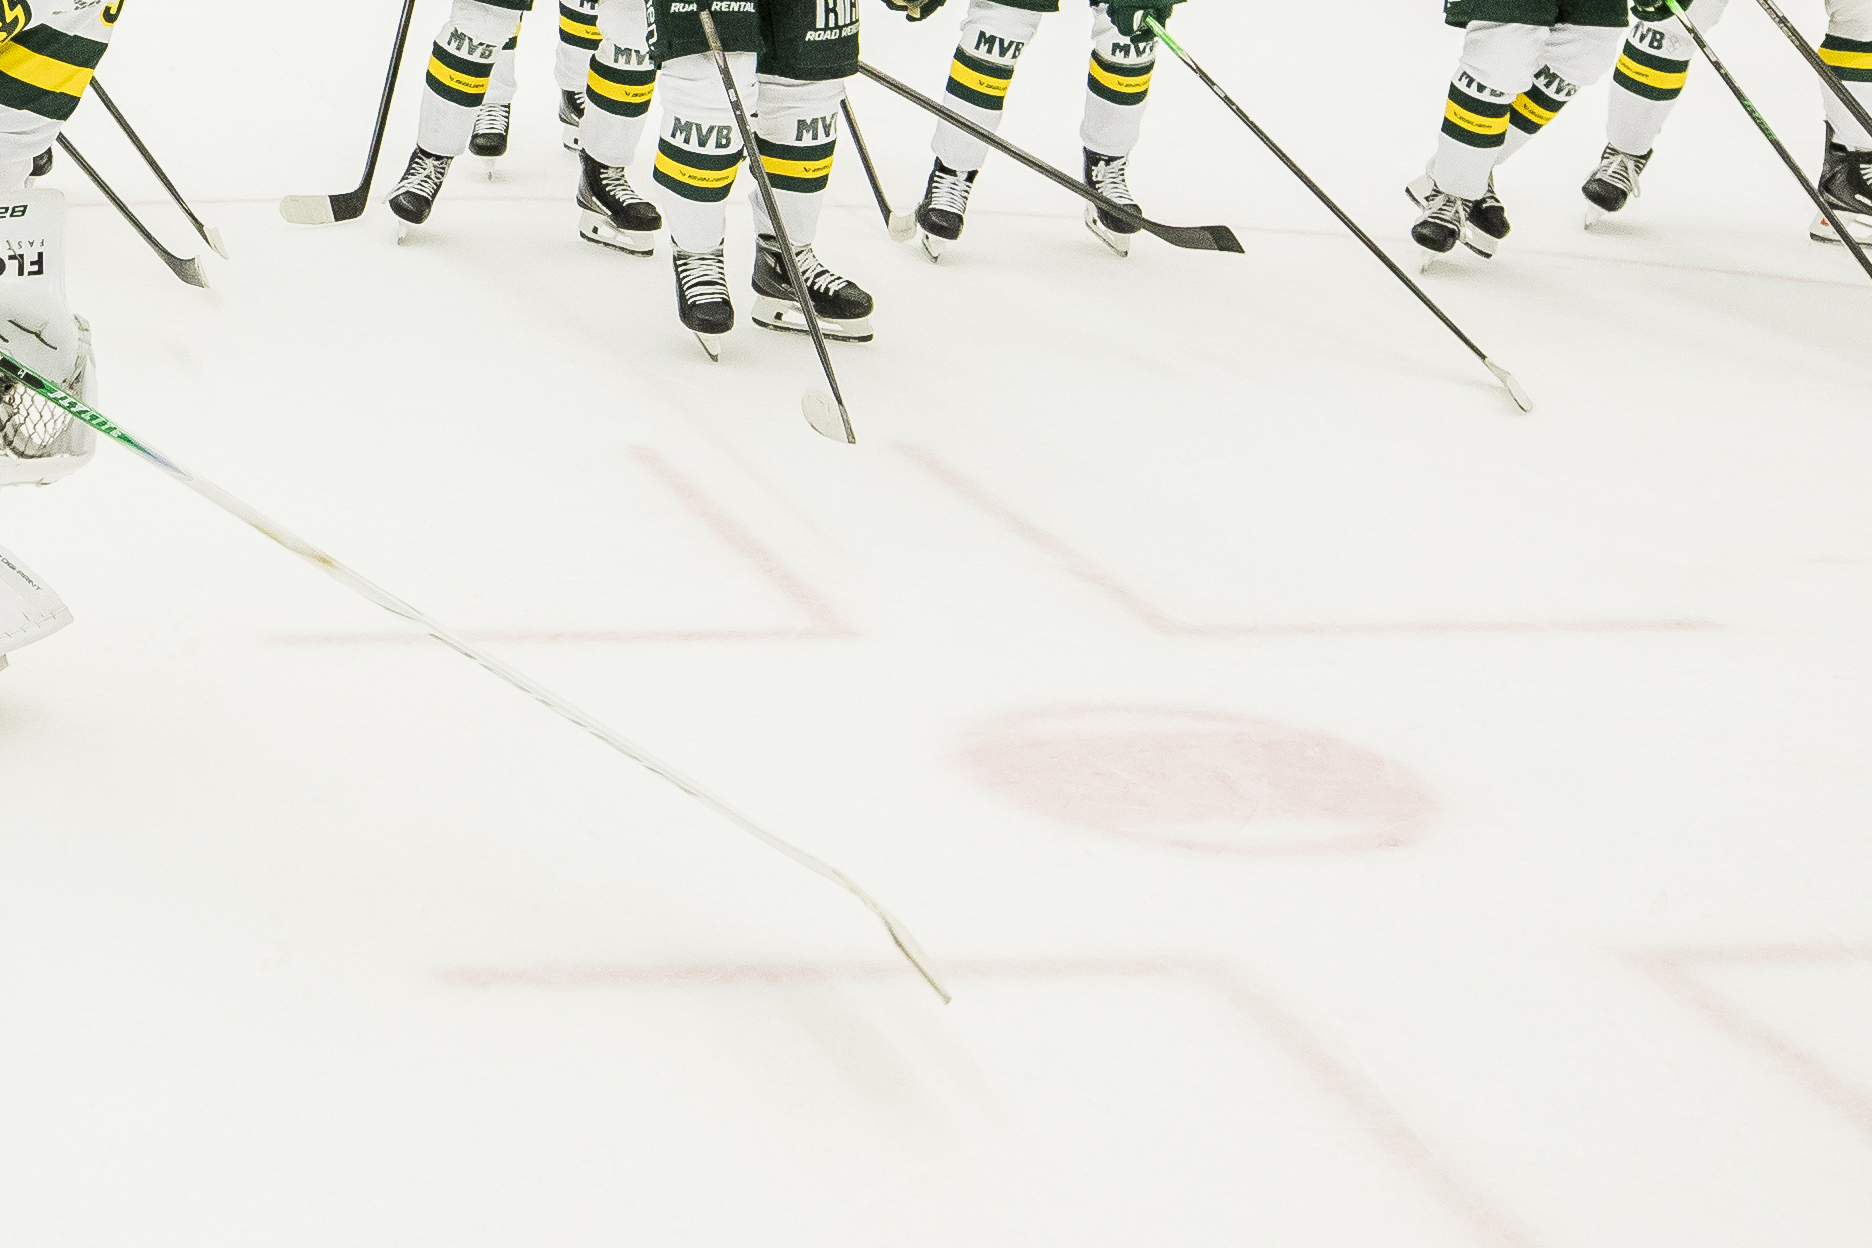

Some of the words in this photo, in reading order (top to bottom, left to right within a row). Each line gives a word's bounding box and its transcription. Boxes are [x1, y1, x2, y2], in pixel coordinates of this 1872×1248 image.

[711, 0, 756, 14] RENTAL
[805, 28, 840, 42] ROAD
[670, 115, 734, 149] MVB
